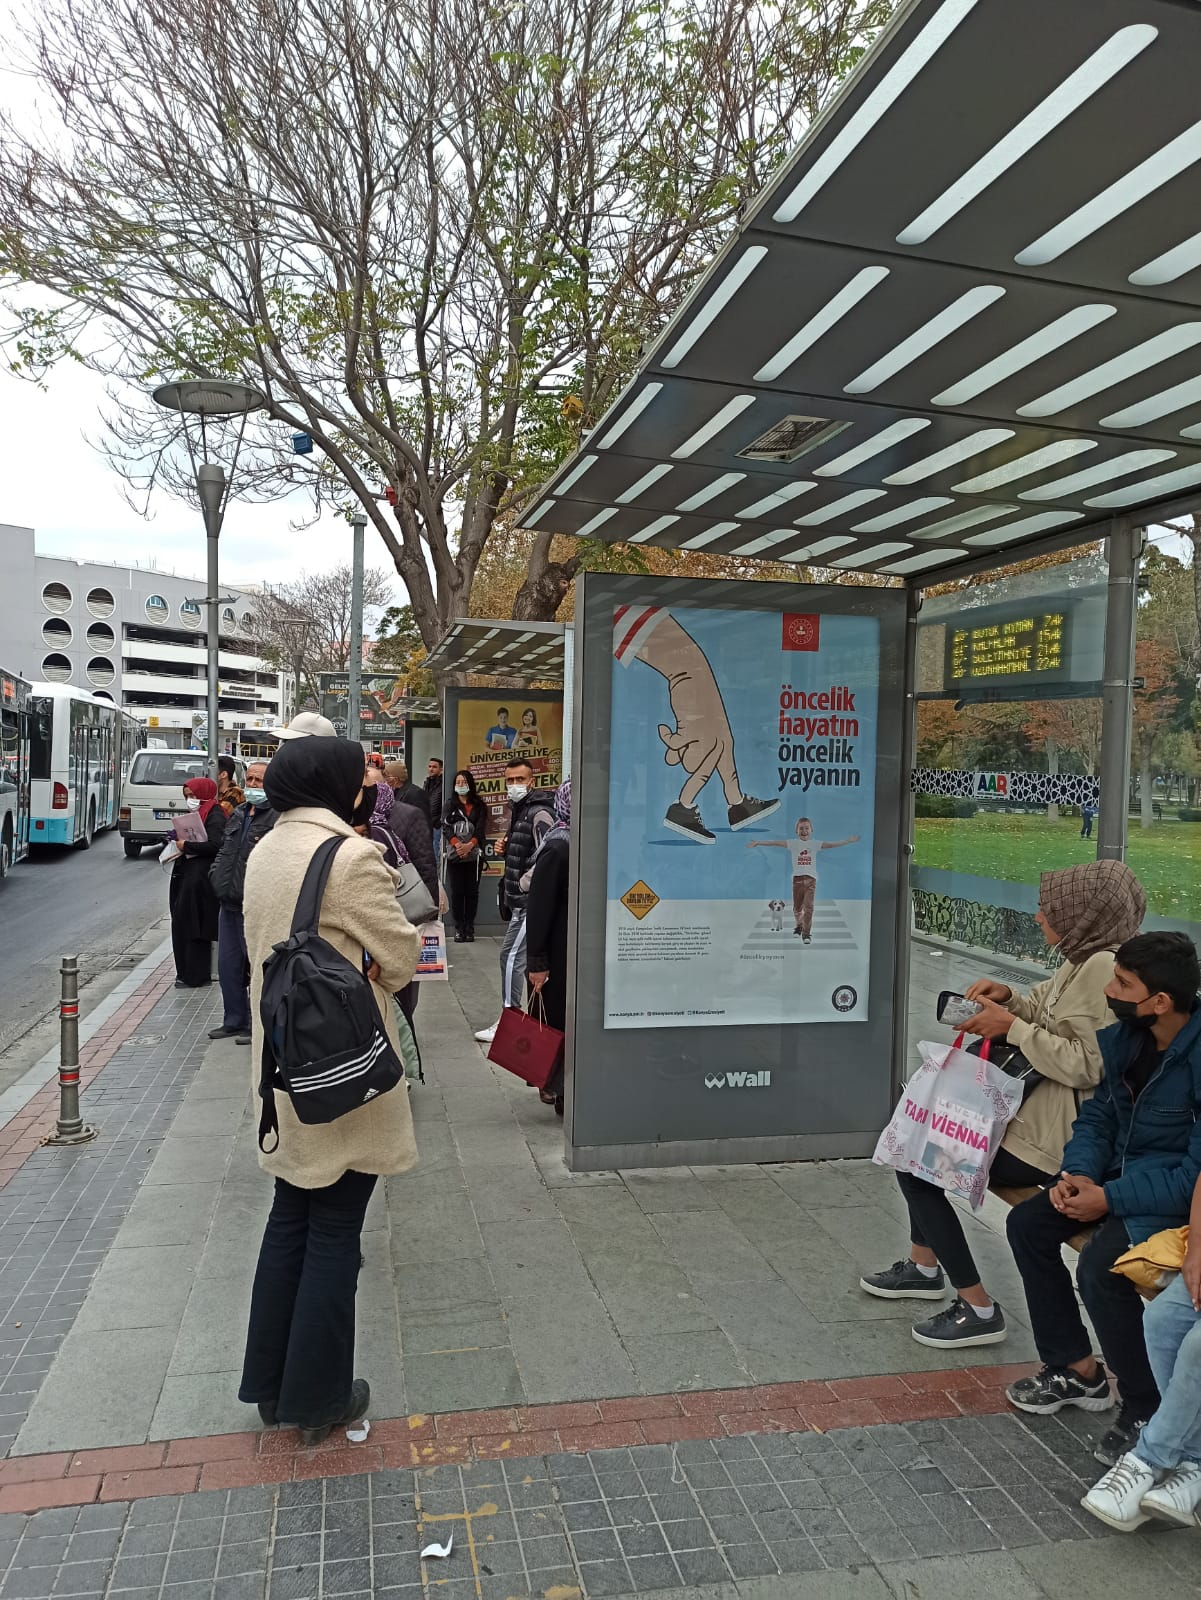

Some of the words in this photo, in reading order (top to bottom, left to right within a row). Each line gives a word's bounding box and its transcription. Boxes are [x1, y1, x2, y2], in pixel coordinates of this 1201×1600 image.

[779, 684, 856, 712] öncelik
[778, 709, 859, 743] hayatın
[778, 737, 854, 764] öncelik
[778, 766, 861, 793] yayanın
[726, 1070, 771, 1087] Wall
